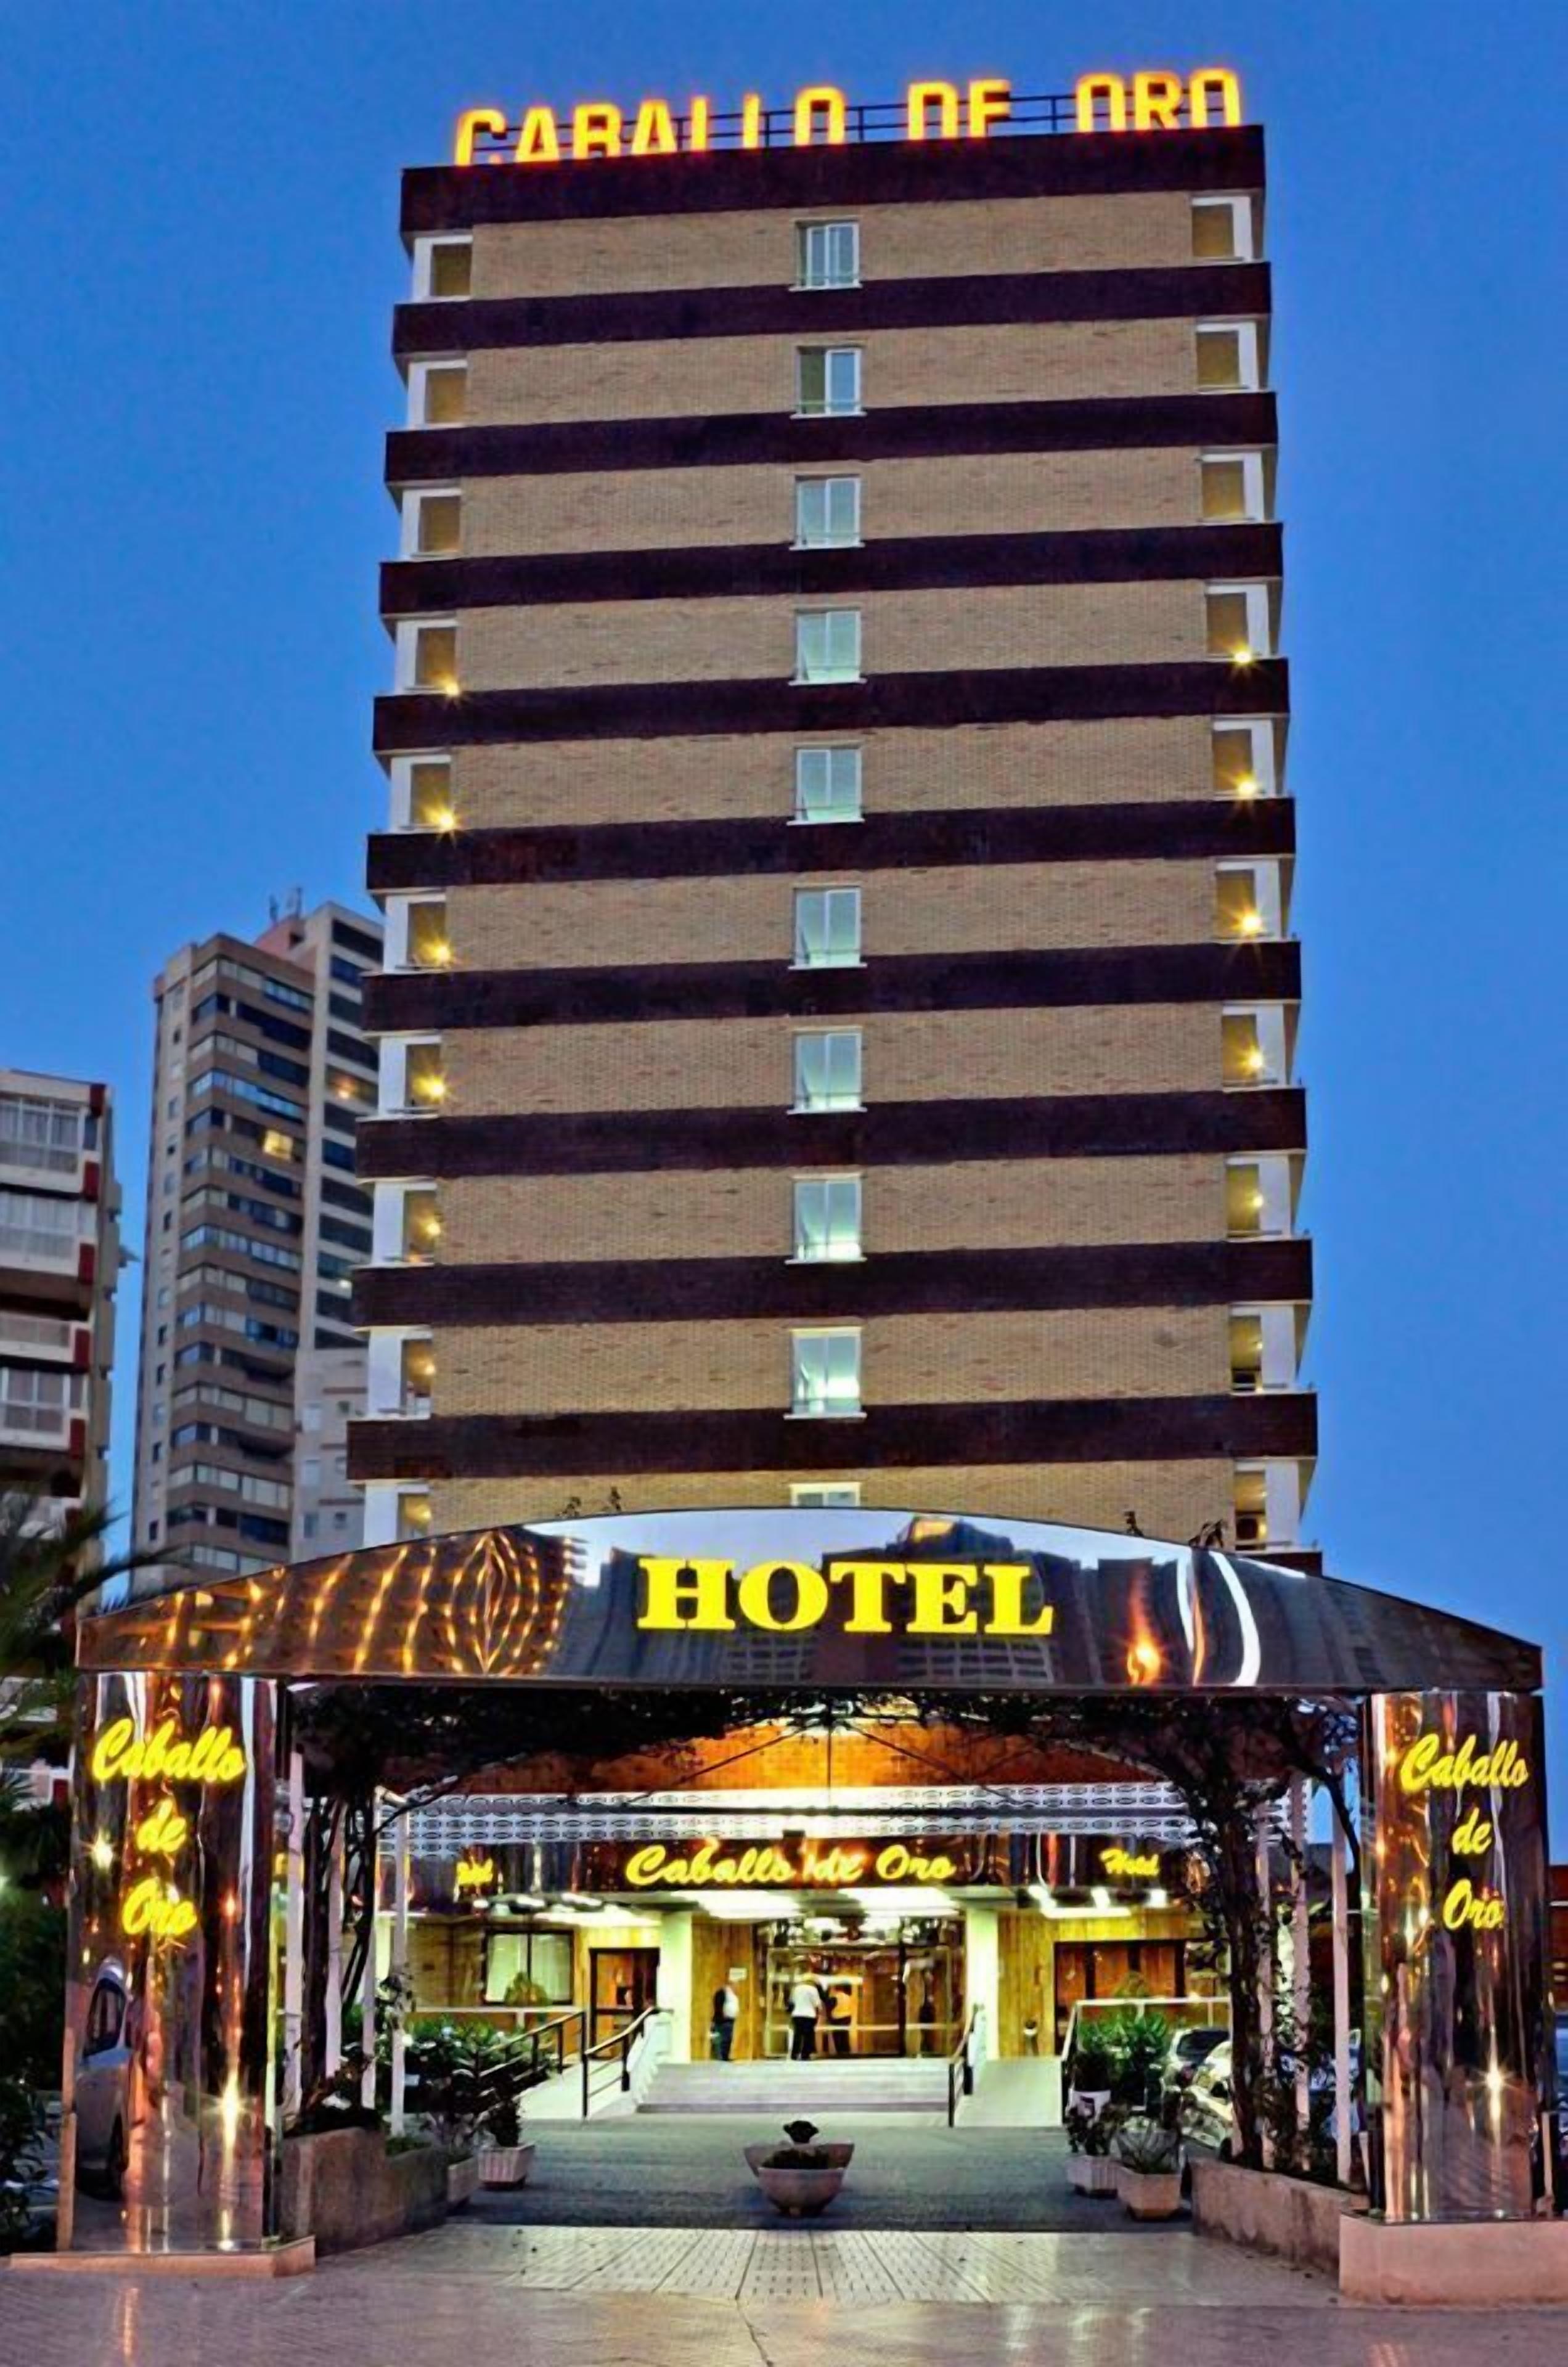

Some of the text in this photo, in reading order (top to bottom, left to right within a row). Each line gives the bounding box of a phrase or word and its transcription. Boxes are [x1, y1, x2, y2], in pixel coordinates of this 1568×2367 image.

[637, 1559, 1053, 1635] HOTEL
[93, 1719, 245, 1780] Caballo
[1400, 1733, 1529, 1791] Caballo
[137, 1799, 187, 1852] de
[1452, 1807, 1492, 1855] de
[626, 1845, 796, 1885] Caballo
[876, 1844, 956, 1880] Oro
[122, 1877, 197, 1935] Oro
[1443, 1879, 1504, 1929] Oro
